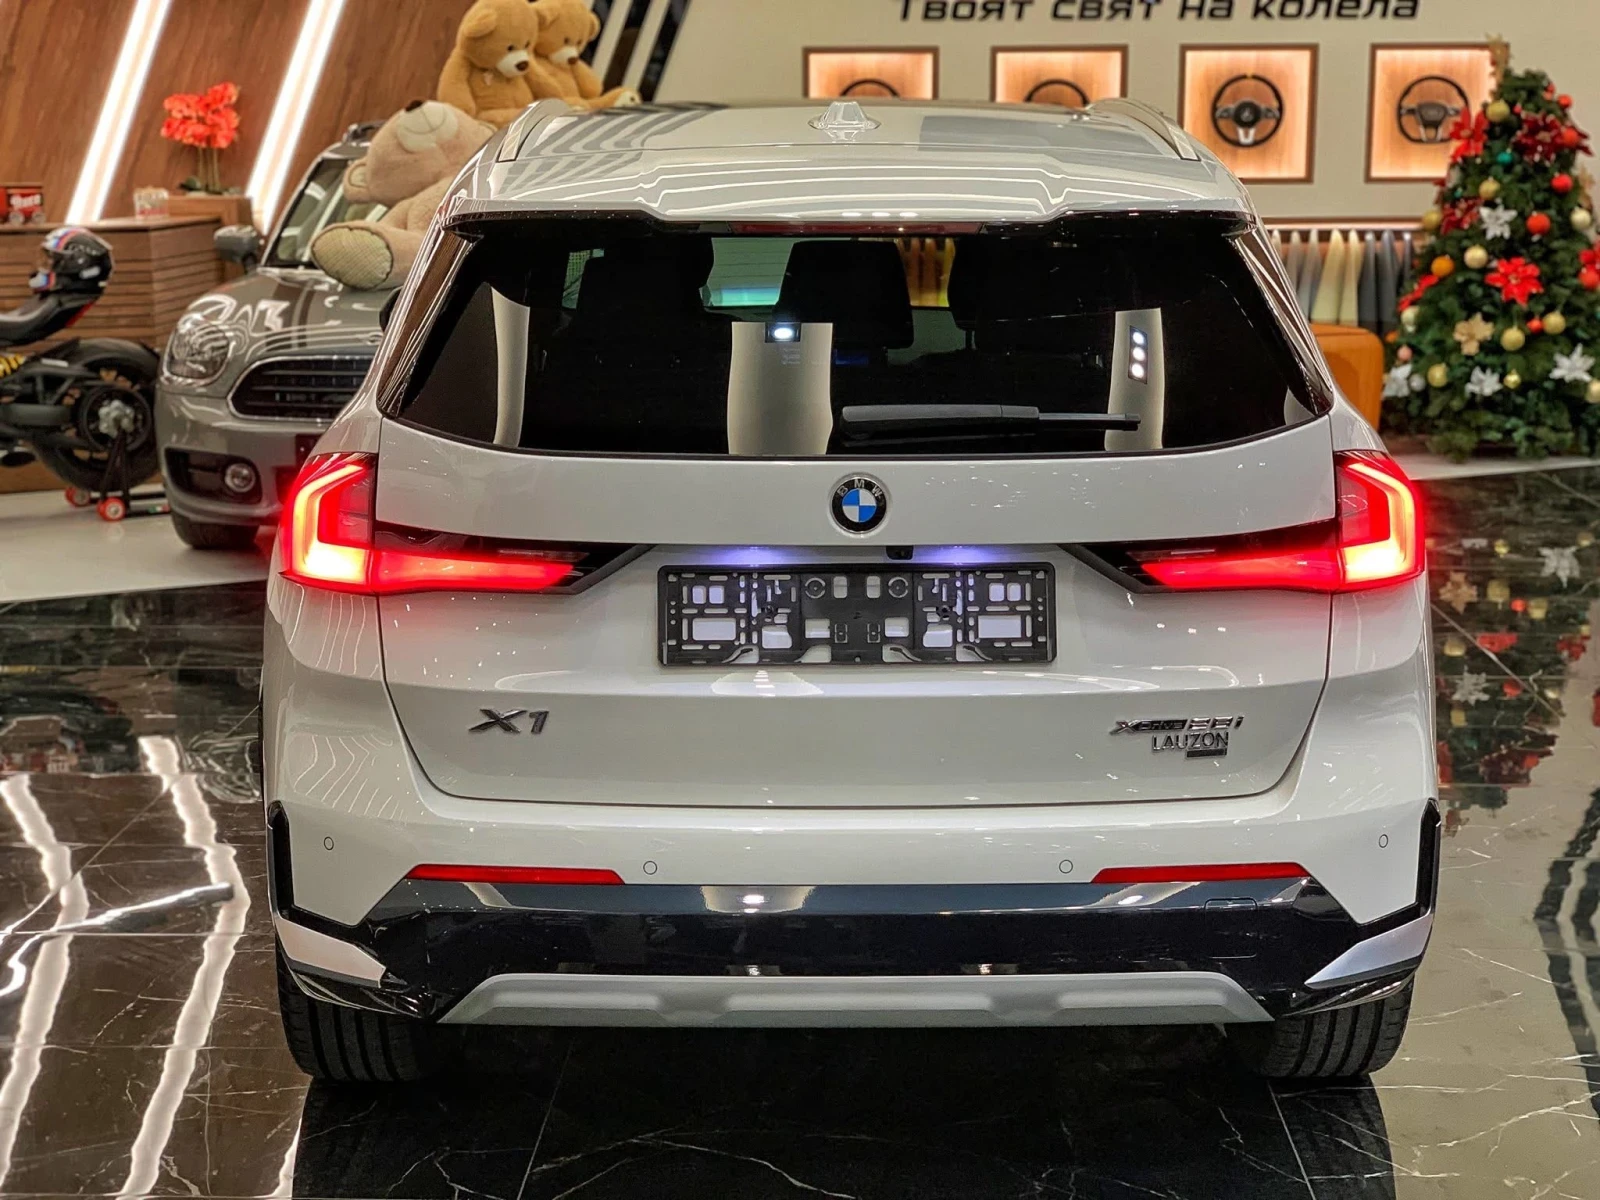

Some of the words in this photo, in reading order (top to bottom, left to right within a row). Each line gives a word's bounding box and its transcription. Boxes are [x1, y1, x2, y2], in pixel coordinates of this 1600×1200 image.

[1050, 0, 1162, 21] свят
[1251, 0, 1420, 21] колела
[837, 478, 883, 498] BMW
[468, 708, 550, 734] X1
[1152, 731, 1229, 752] LAUZON
